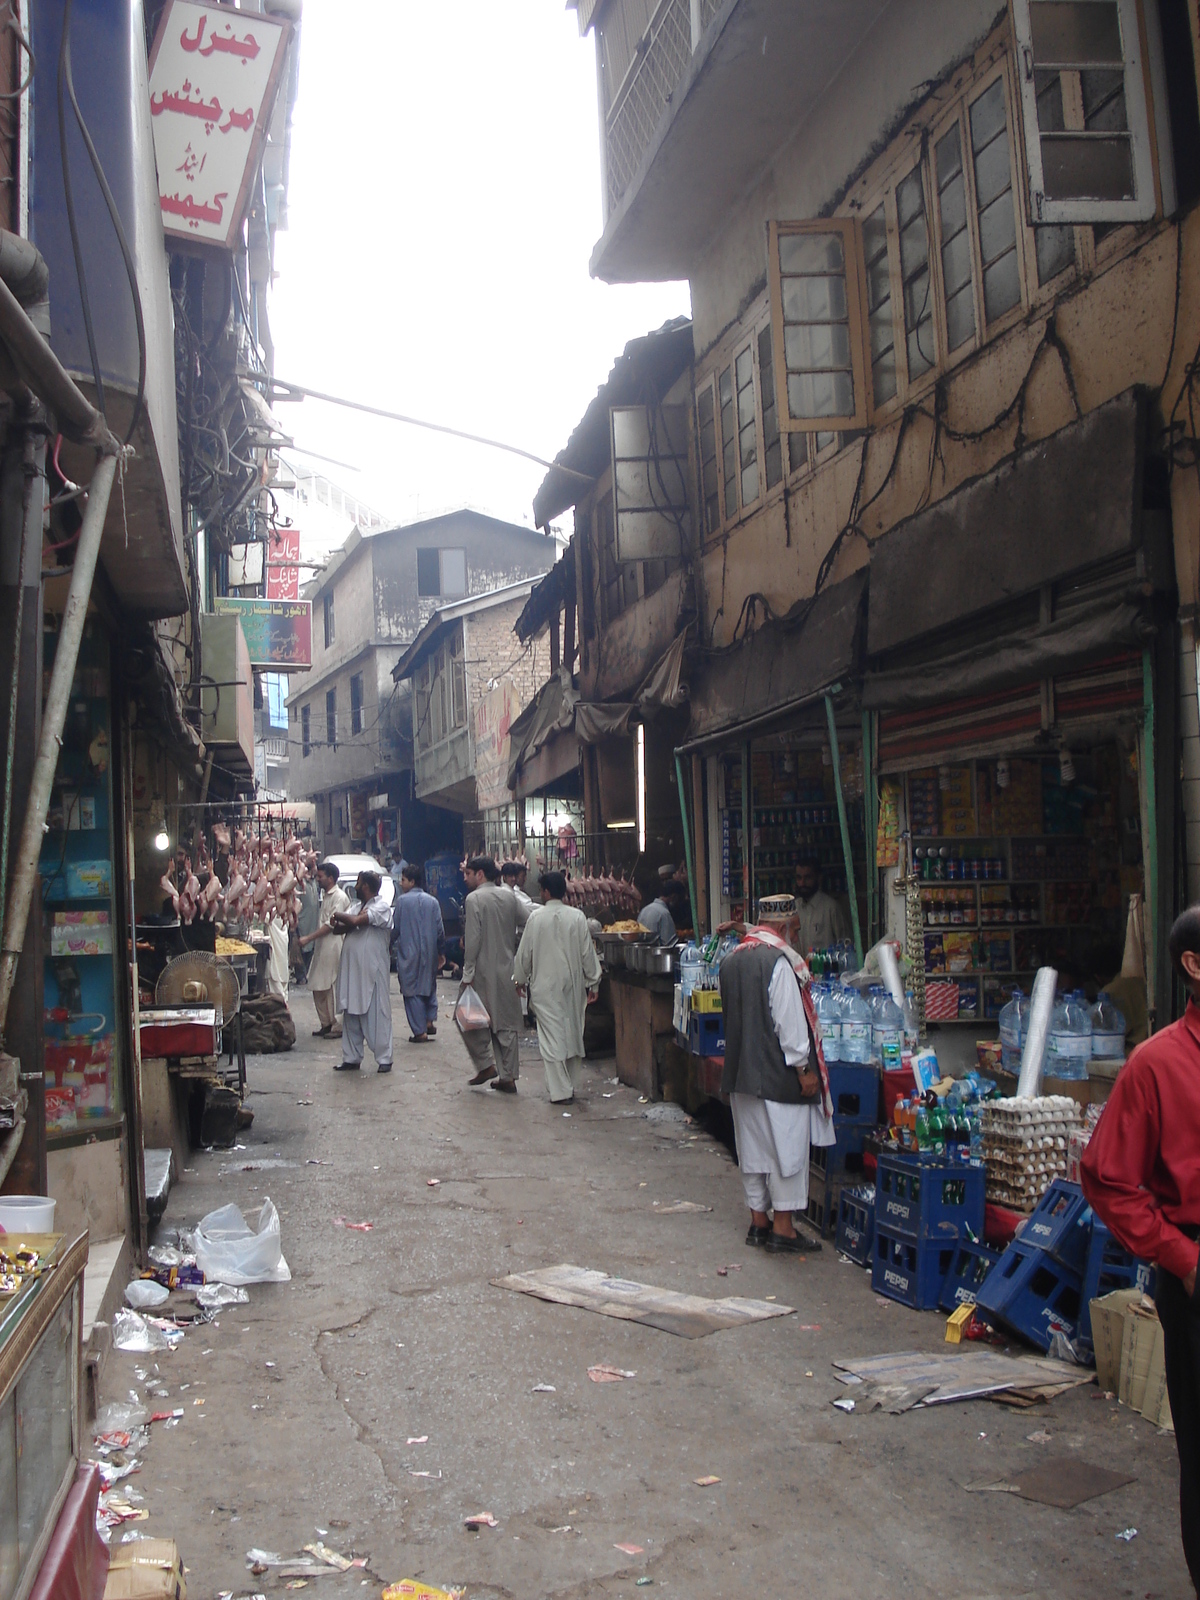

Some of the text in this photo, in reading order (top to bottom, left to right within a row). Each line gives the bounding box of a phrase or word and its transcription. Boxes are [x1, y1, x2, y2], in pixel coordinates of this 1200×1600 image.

[180, 14, 261, 66] جنرل
[150, 78, 255, 136] مرچنٹس
[175, 142, 207, 182] اینڈ
[886, 1201, 910, 1219] PEPSI
[845, 1227, 861, 1242] PEPSI
[1031, 1223, 1053, 1236] PEPSI
[884, 1269, 909, 1291] PEPSI
[1041, 1307, 1074, 1334] PEPSI
